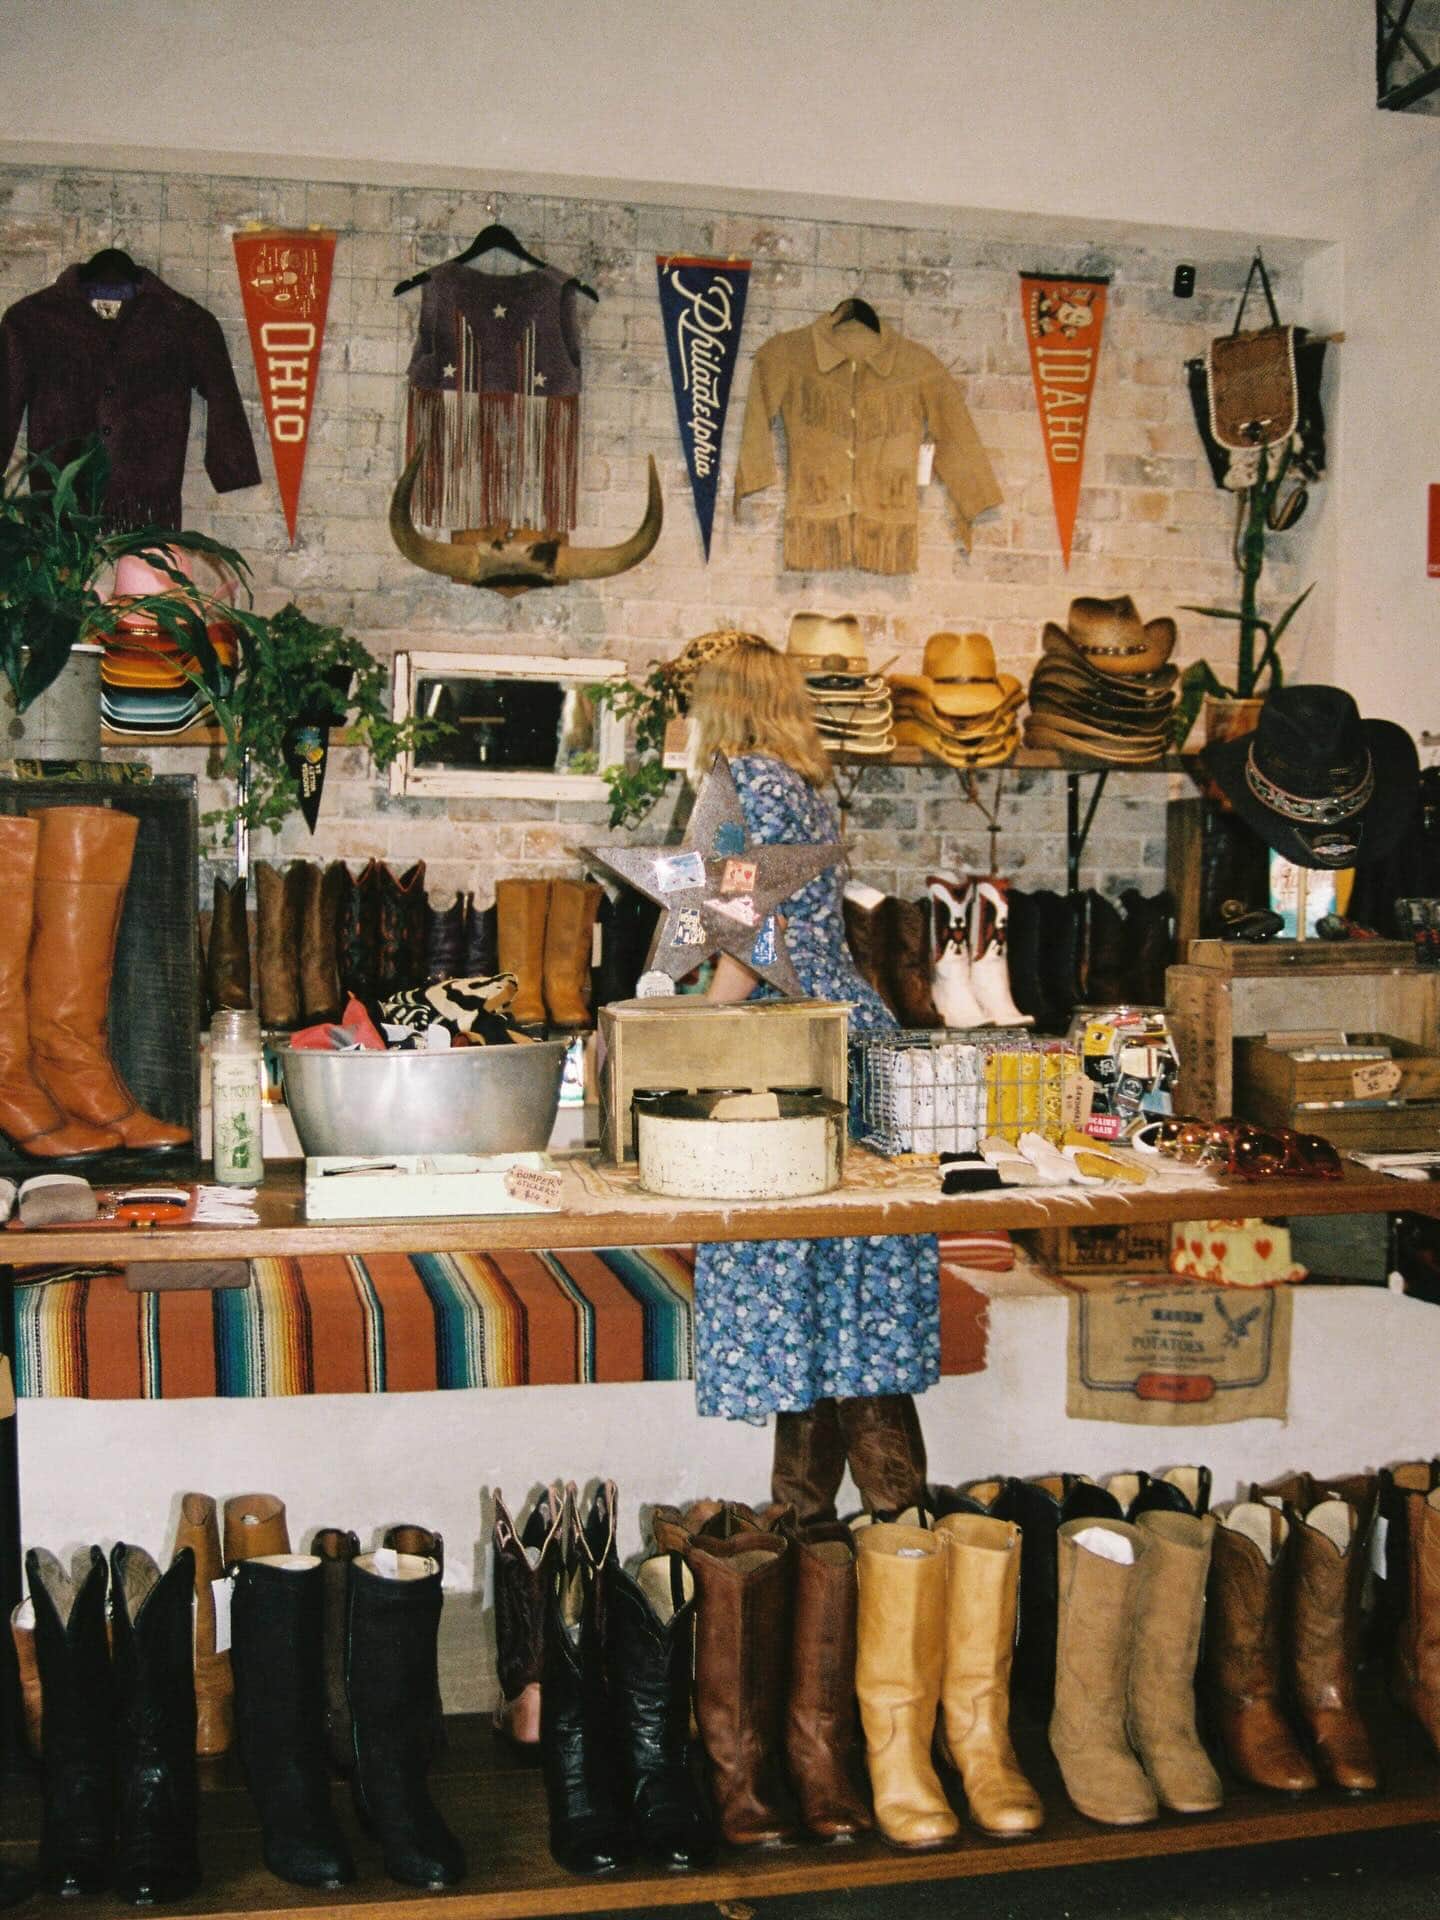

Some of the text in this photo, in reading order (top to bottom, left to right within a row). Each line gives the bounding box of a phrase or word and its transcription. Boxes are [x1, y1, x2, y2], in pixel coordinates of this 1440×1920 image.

[260, 322, 316, 443] OHIO
[671, 270, 734, 478] Philadelphia
[1036, 346, 1092, 463] IDAHO
[1131, 1336, 1205, 1352] POTATOES
